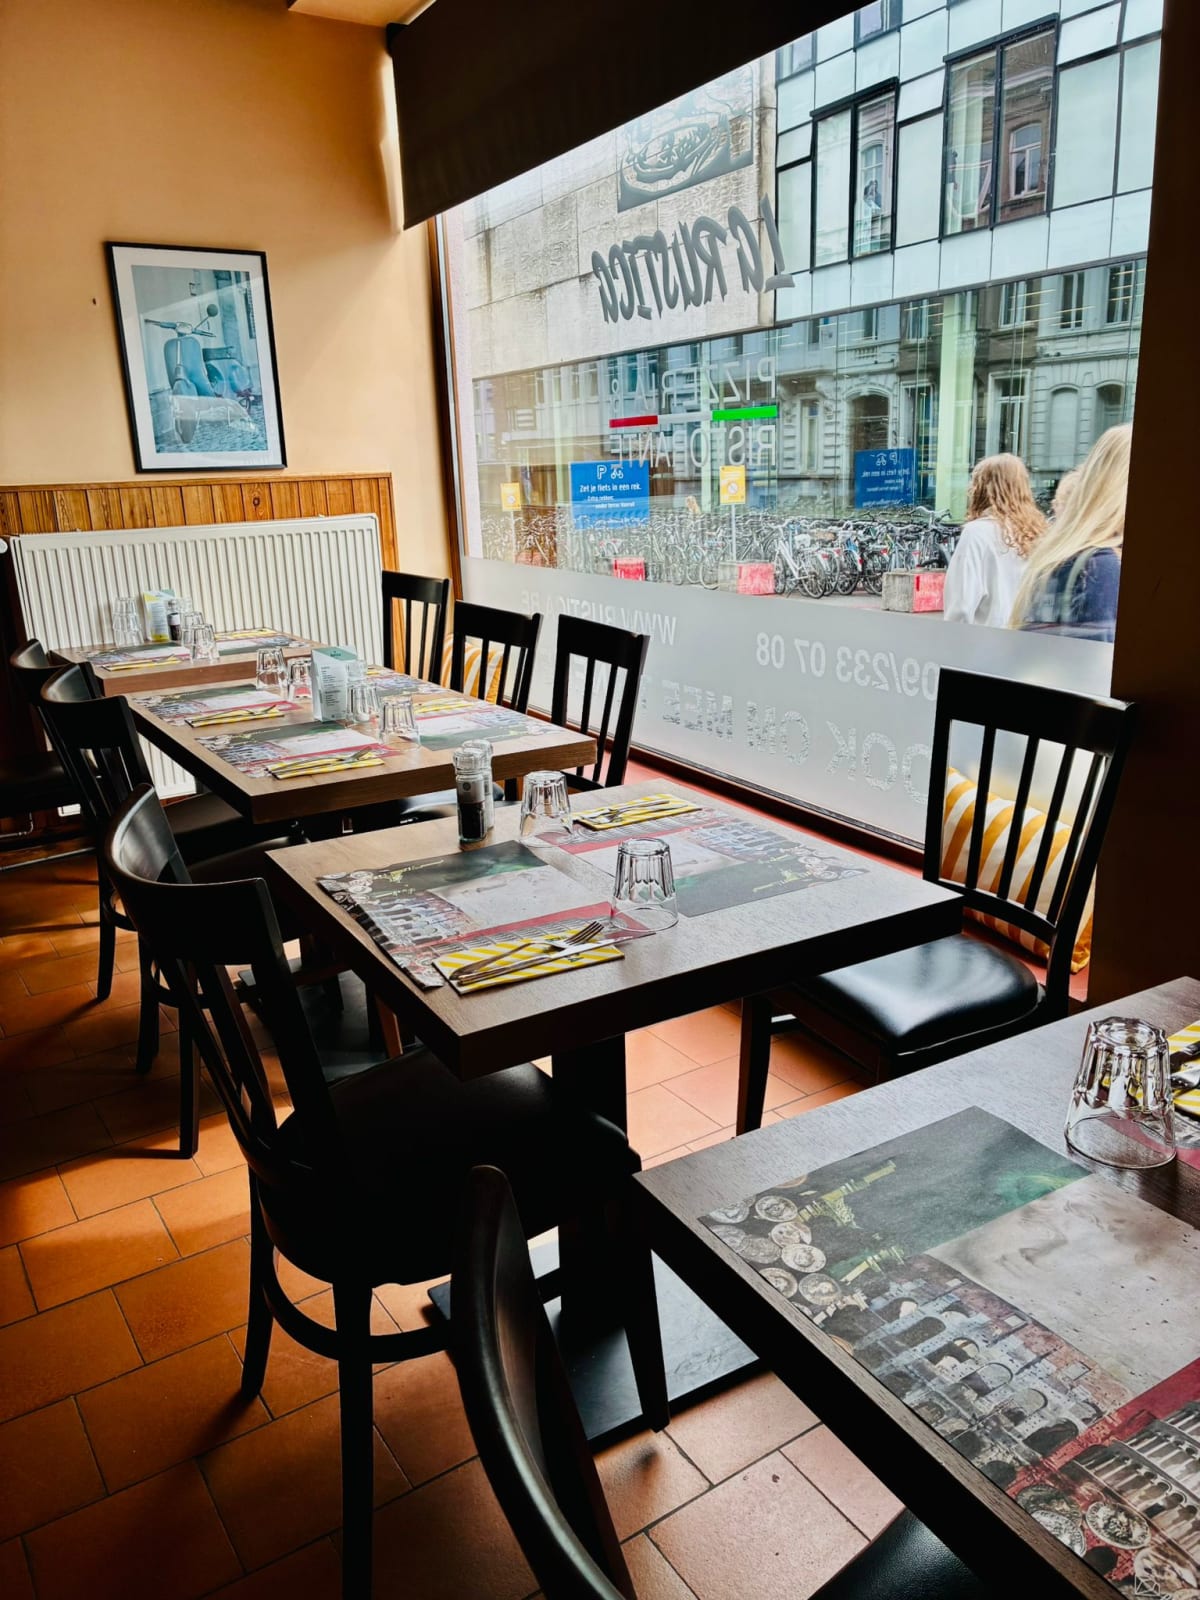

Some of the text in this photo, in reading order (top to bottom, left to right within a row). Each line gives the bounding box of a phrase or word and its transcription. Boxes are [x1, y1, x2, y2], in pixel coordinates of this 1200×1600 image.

[579, 484, 590, 493] Zet
[590, 484, 597, 494] je
[597, 483, 611, 492] fiets
[612, 483, 618, 491] in
[618, 483, 630, 491] een
